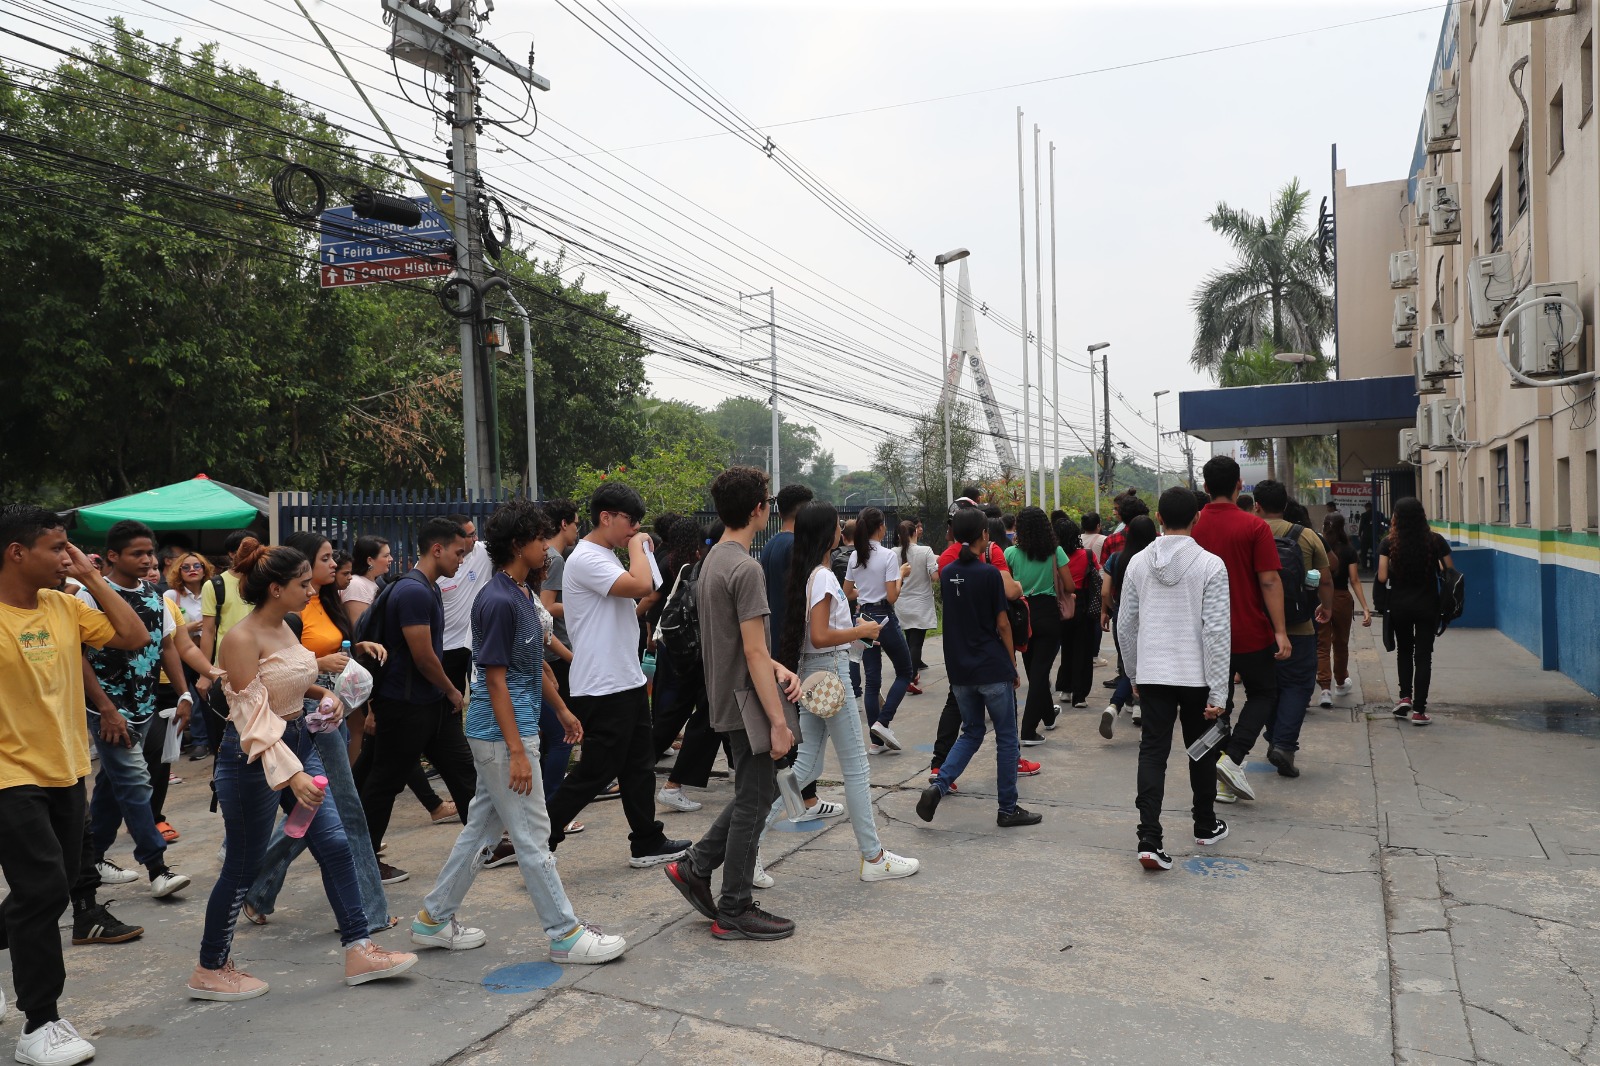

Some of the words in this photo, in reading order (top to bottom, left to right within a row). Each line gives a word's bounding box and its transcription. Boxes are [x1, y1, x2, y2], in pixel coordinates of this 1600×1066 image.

[343, 246, 373, 258] Feira
[361, 266, 401, 279] Centro
[1336, 486, 1373, 495] ATENÇÃO
